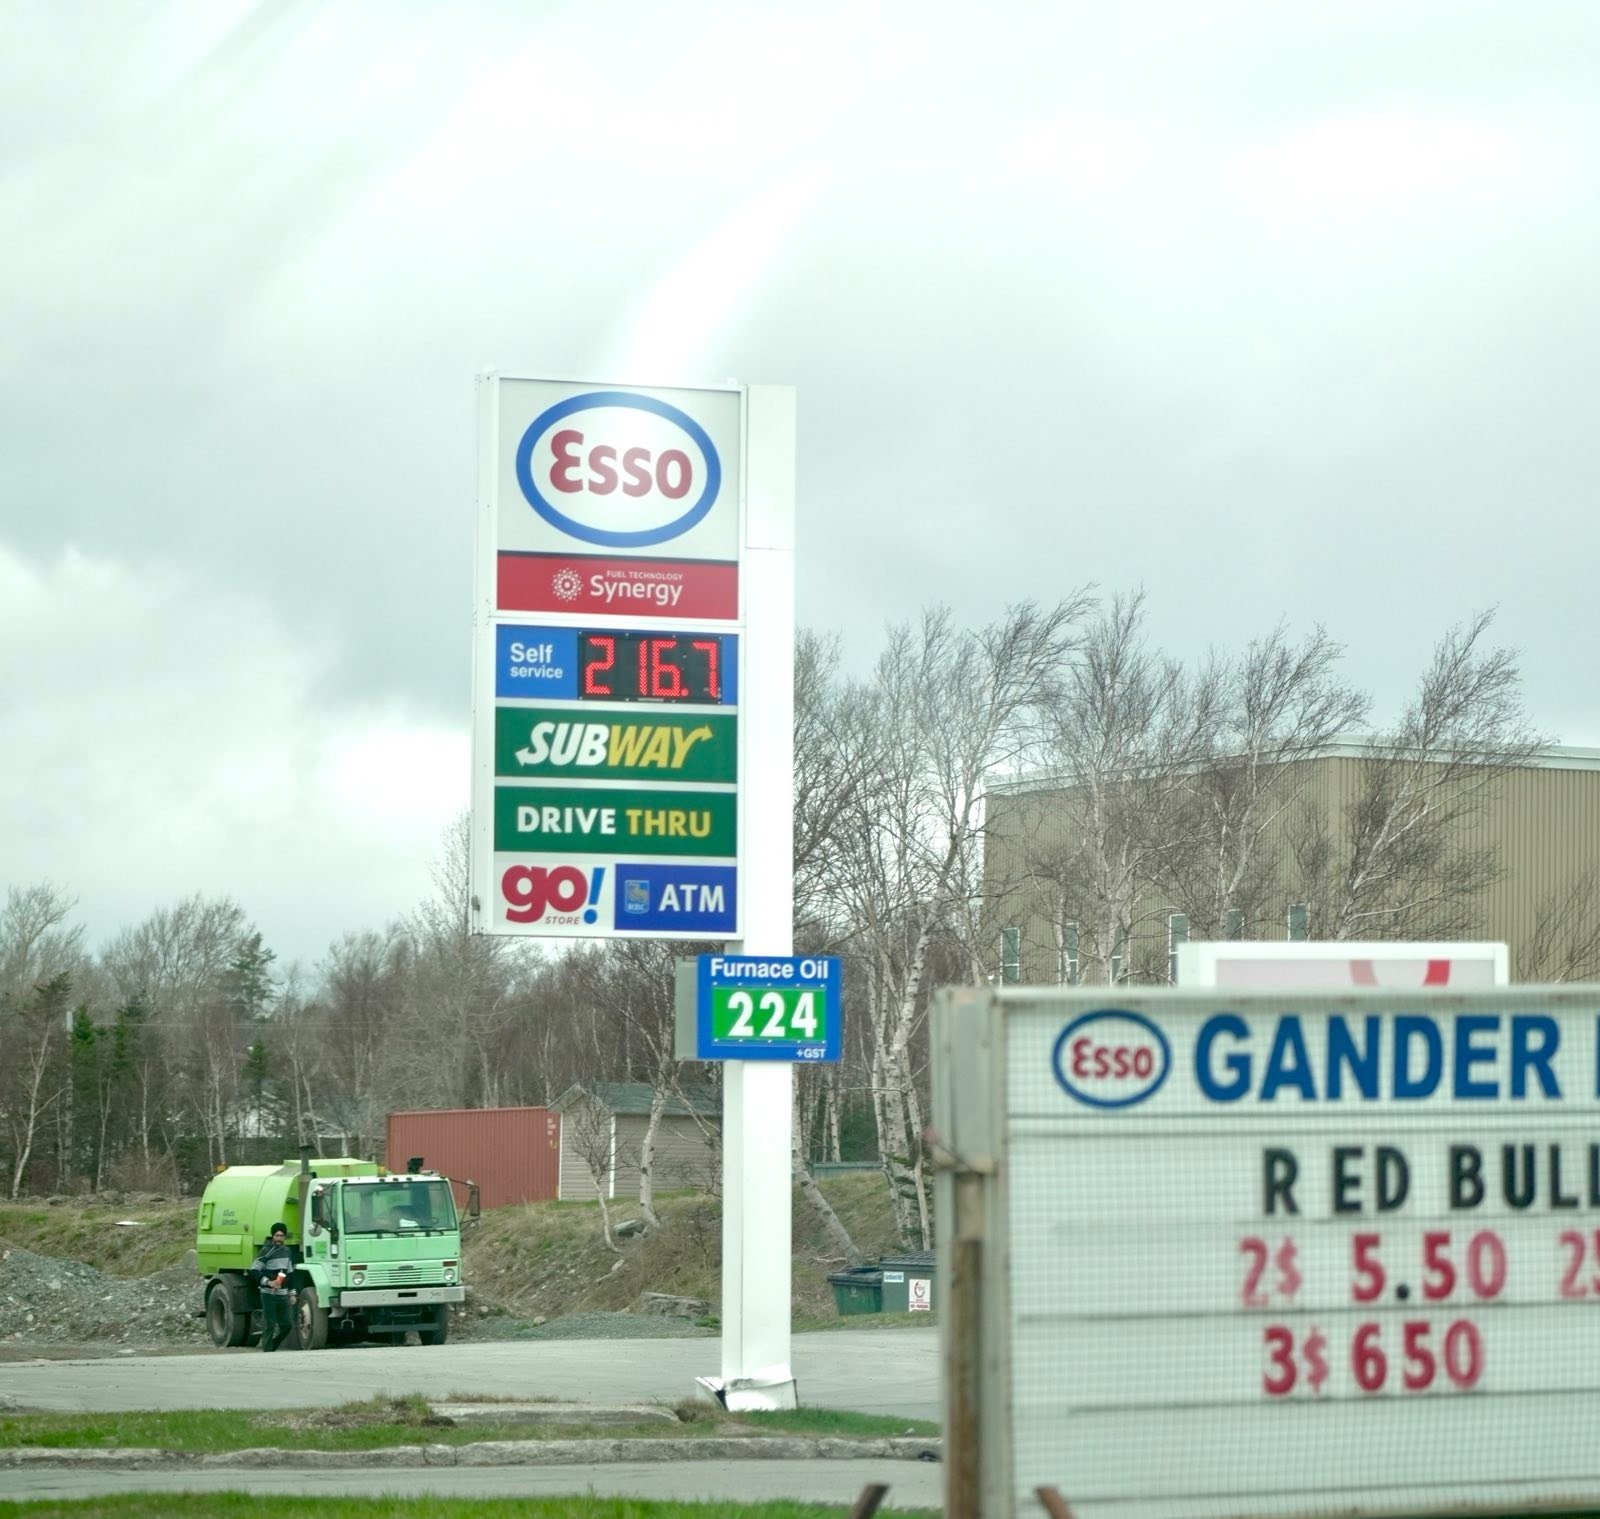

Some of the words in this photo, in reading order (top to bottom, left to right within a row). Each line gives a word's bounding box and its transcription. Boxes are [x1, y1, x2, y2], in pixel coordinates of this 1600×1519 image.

[550, 429, 693, 500] Esso
[590, 575, 683, 606] Synergy
[606, 570, 626, 578] FUEL
[629, 572, 683, 581] TECHNOLOGY
[510, 643, 553, 663] Self
[510, 666, 563, 679] service
[515, 722, 713, 768] SUBWAY
[517, 806, 616, 834] DRIVE
[626, 810, 711, 837] THRU
[502, 865, 605, 925] go!
[659, 884, 725, 912] ATM
[545, 916, 580, 925] STORE
[711, 958, 794, 978] Furnace
[800, 959, 829, 979] Oil
[728, 991, 818, 1038] 224
[1072, 1036, 1154, 1079] Esso
[1195, 1013, 1563, 1102] GANDER
[1238, 1234, 1303, 1309] 2$
[1352, 1230, 1508, 1304] 5.50
[1263, 1322, 1329, 1397] 3$
[1351, 1318, 1485, 1392] 650
